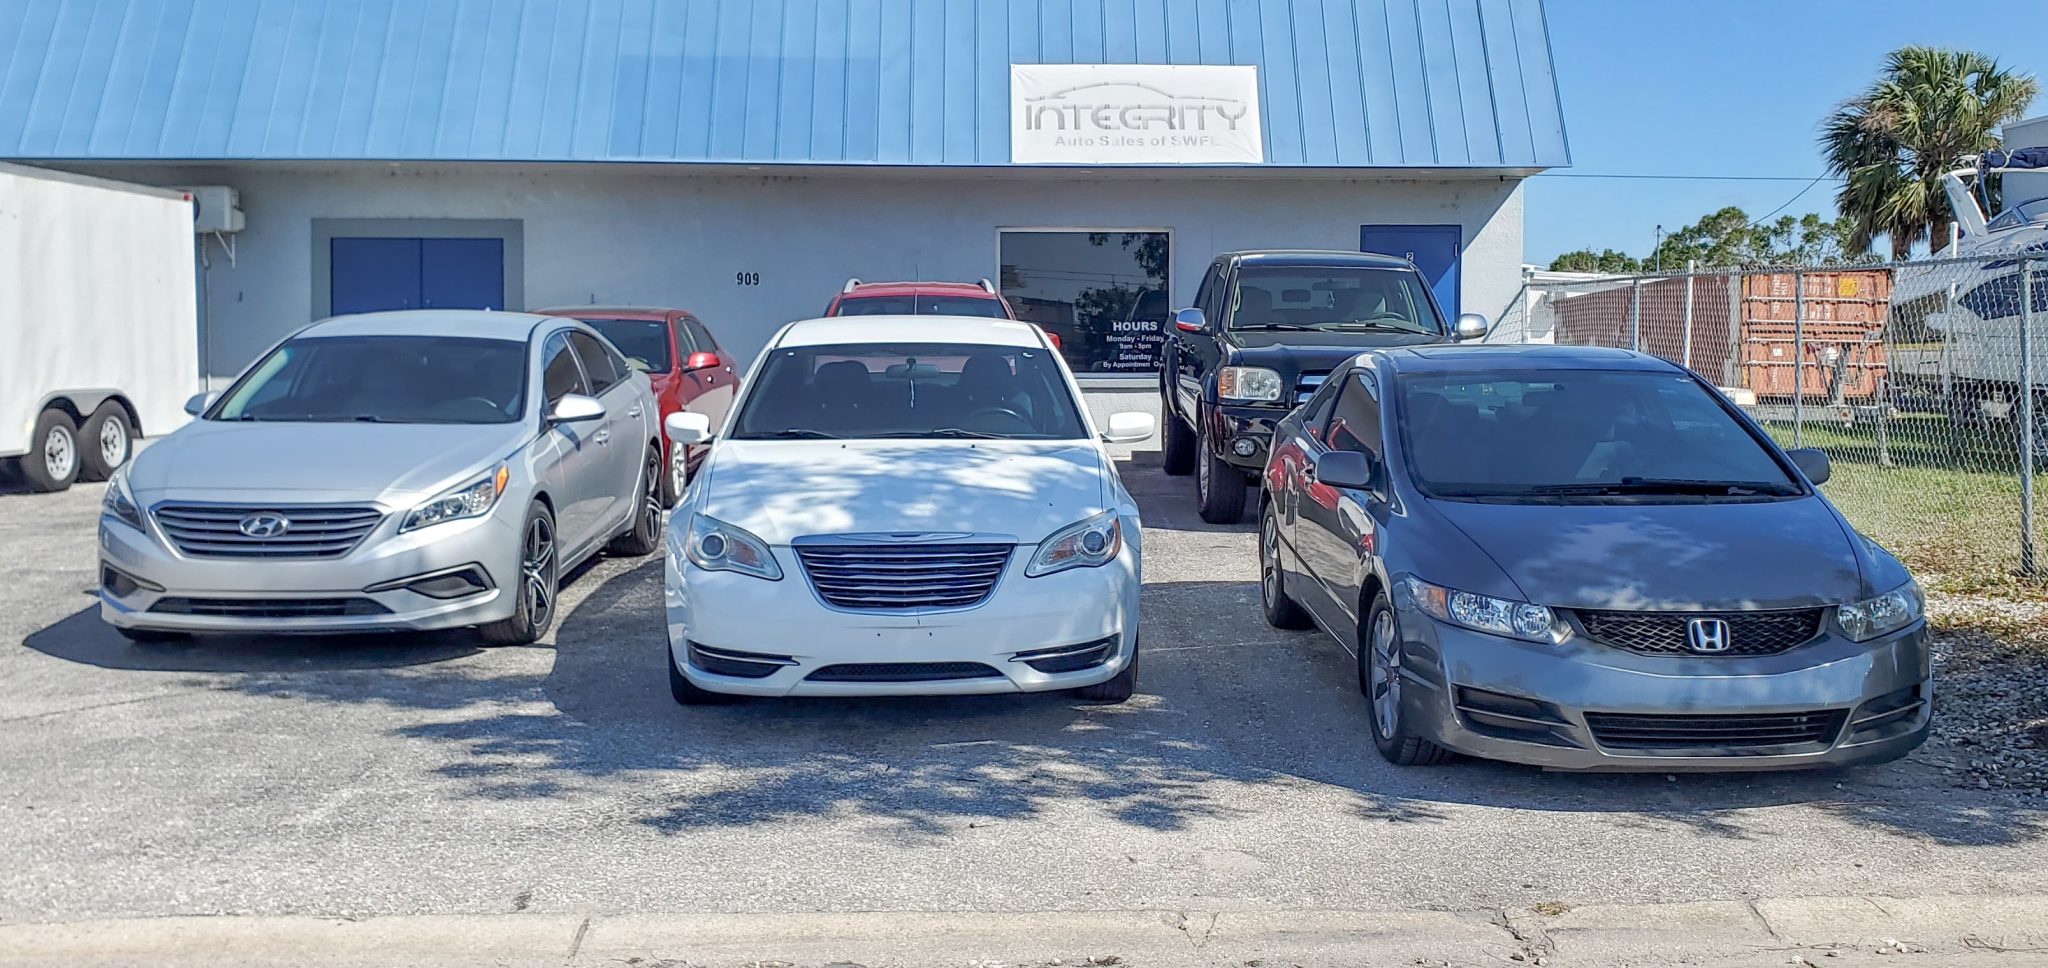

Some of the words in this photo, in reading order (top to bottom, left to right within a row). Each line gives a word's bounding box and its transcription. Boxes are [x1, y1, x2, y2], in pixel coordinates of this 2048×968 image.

[1025, 104, 1247, 130] INTEGRITY
[1055, 135, 1095, 147] Auto
[1099, 135, 1145, 147] Sales
[1150, 135, 1167, 147] of
[736, 272, 760, 286] 909
[1113, 321, 1158, 331] HOURS
[1106, 335, 1135, 343] Monday
[1141, 335, 1164, 343] Friday
[1119, 353, 1152, 361] Saturday
